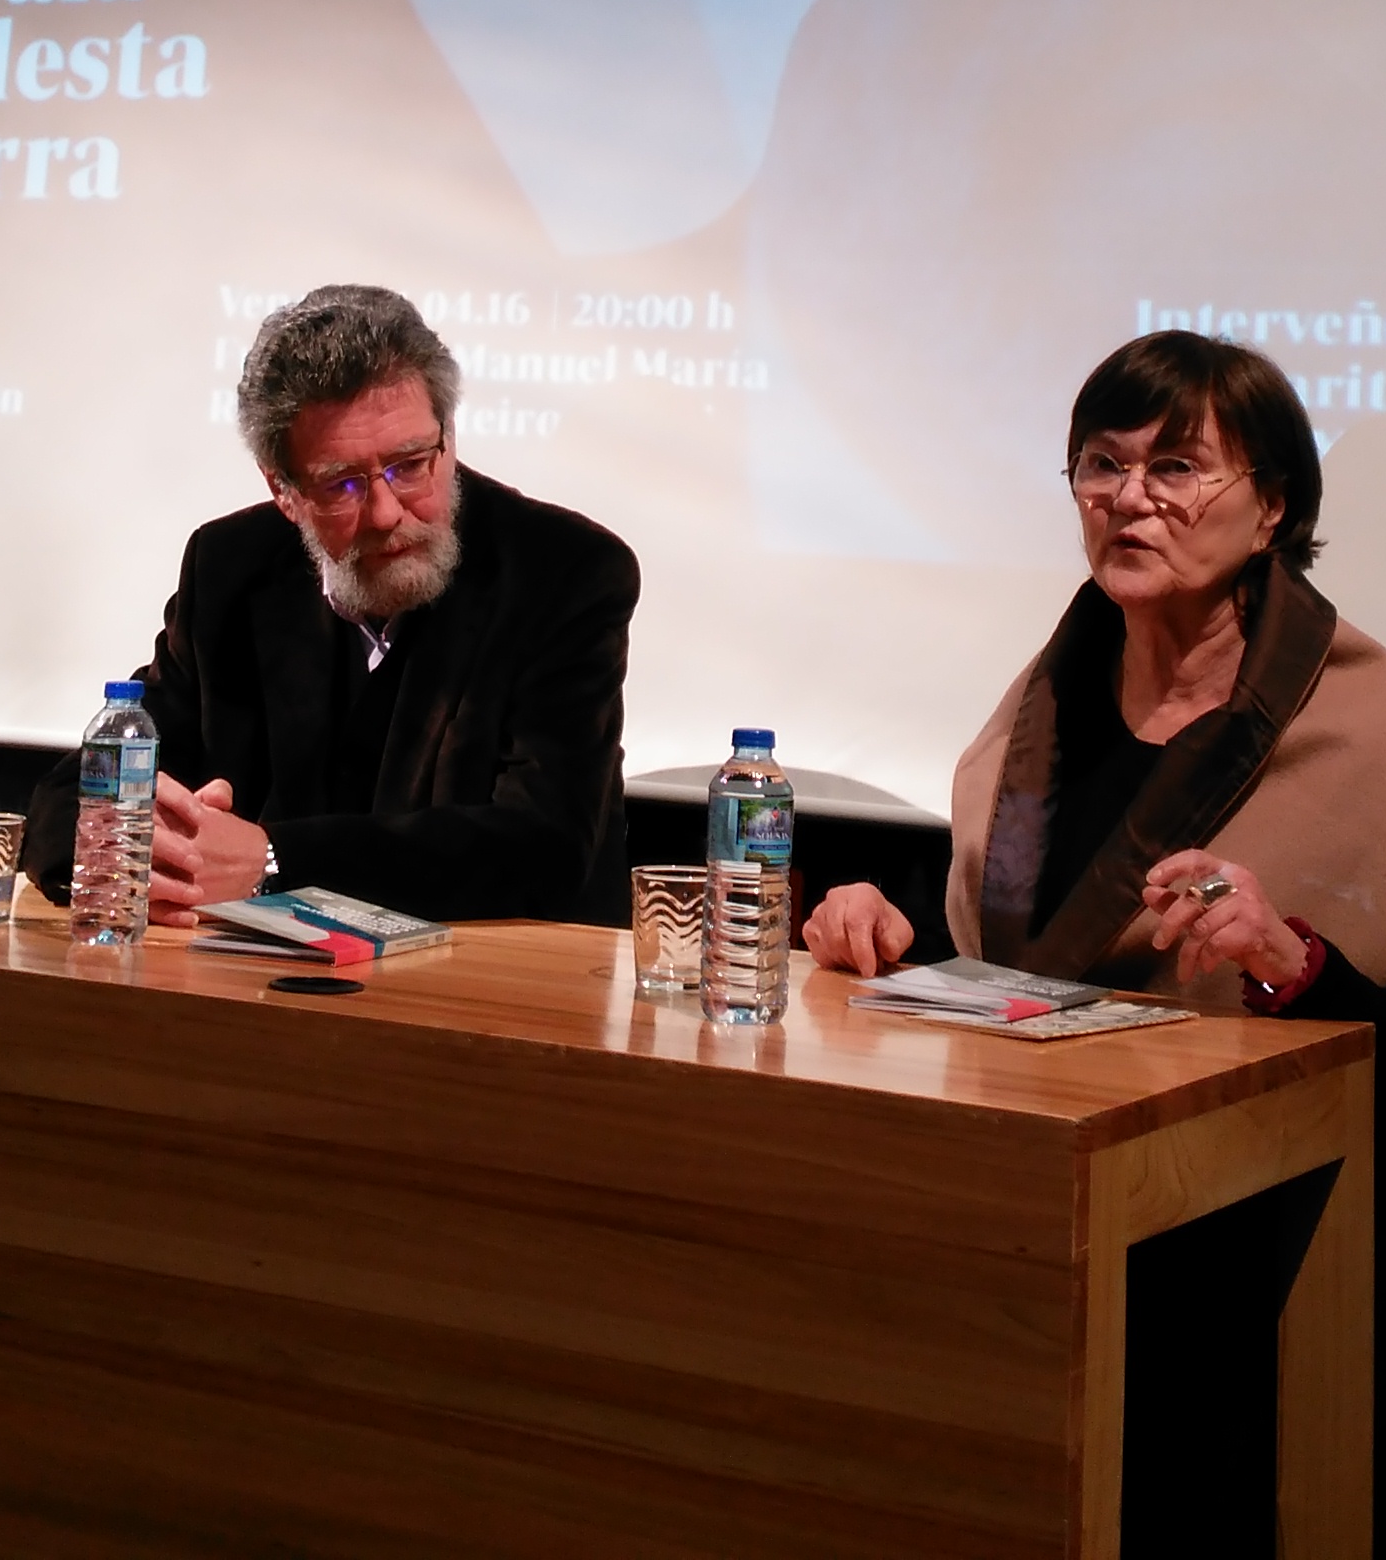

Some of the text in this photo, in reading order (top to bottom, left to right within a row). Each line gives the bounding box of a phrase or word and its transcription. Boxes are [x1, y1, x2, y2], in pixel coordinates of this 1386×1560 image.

[572, 292, 695, 329] 20:00
[706, 290, 734, 331] h
[454, 342, 617, 382] Manuel
